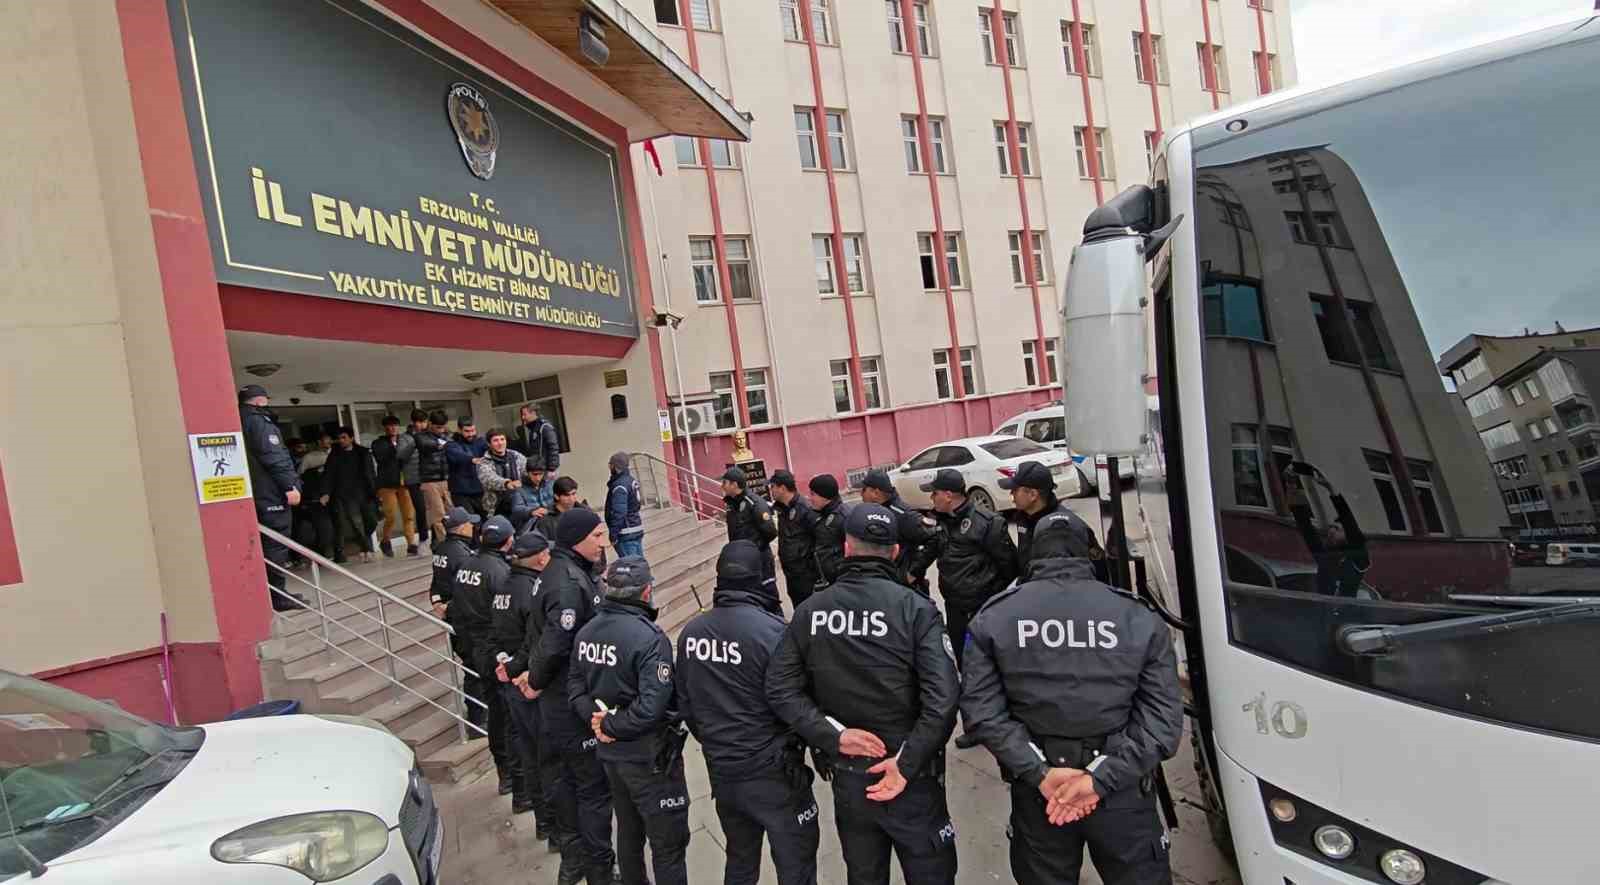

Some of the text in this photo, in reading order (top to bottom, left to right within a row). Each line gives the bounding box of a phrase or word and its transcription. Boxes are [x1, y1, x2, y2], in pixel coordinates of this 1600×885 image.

[419, 197, 541, 247] ERZURUM VALİLİĞİ
[469, 192, 500, 215] T.C.
[251, 167, 622, 298] İL EMNİYET MÜDÜRLÜĞÜ
[328, 270, 601, 330] YAKUTİYE İLÇE EMNİYET MÜDÜRLÜĞÜ
[424, 262, 552, 301] EK HİZMET BİNASI
